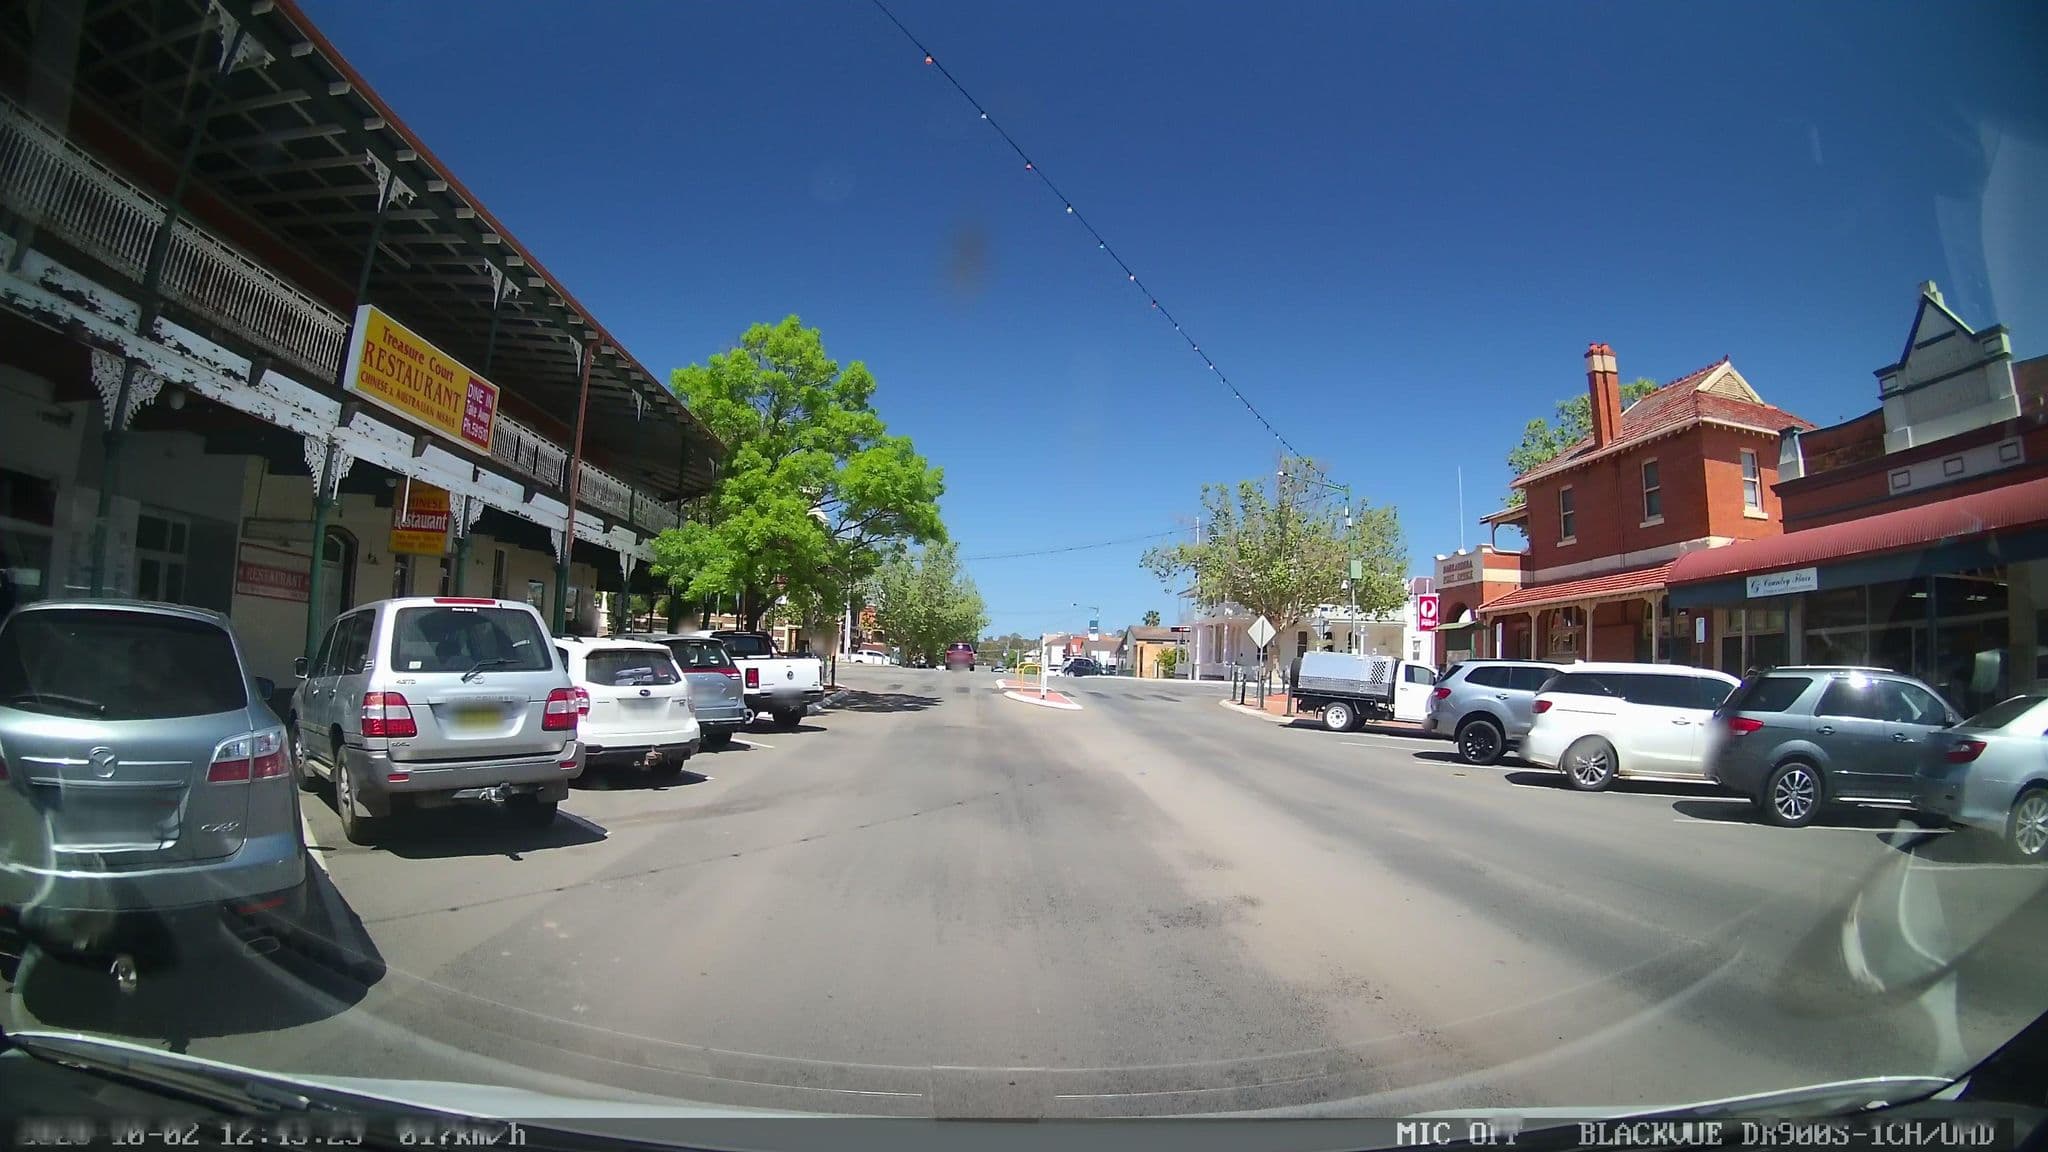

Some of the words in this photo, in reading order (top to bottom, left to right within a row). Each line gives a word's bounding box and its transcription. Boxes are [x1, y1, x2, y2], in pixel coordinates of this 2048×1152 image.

[383, 326, 425, 365] Treasure
[429, 357, 455, 383] Court
[360, 370, 388, 394] CHINESE
[396, 390, 434, 418] AUSTRALIAN
[362, 341, 462, 413] RESTAURANT
[468, 383, 484, 404] DINE
[486, 393, 493, 408] IN
[395, 509, 447, 531] Restaurant
[246, 567, 304, 589] RESTAURANT
